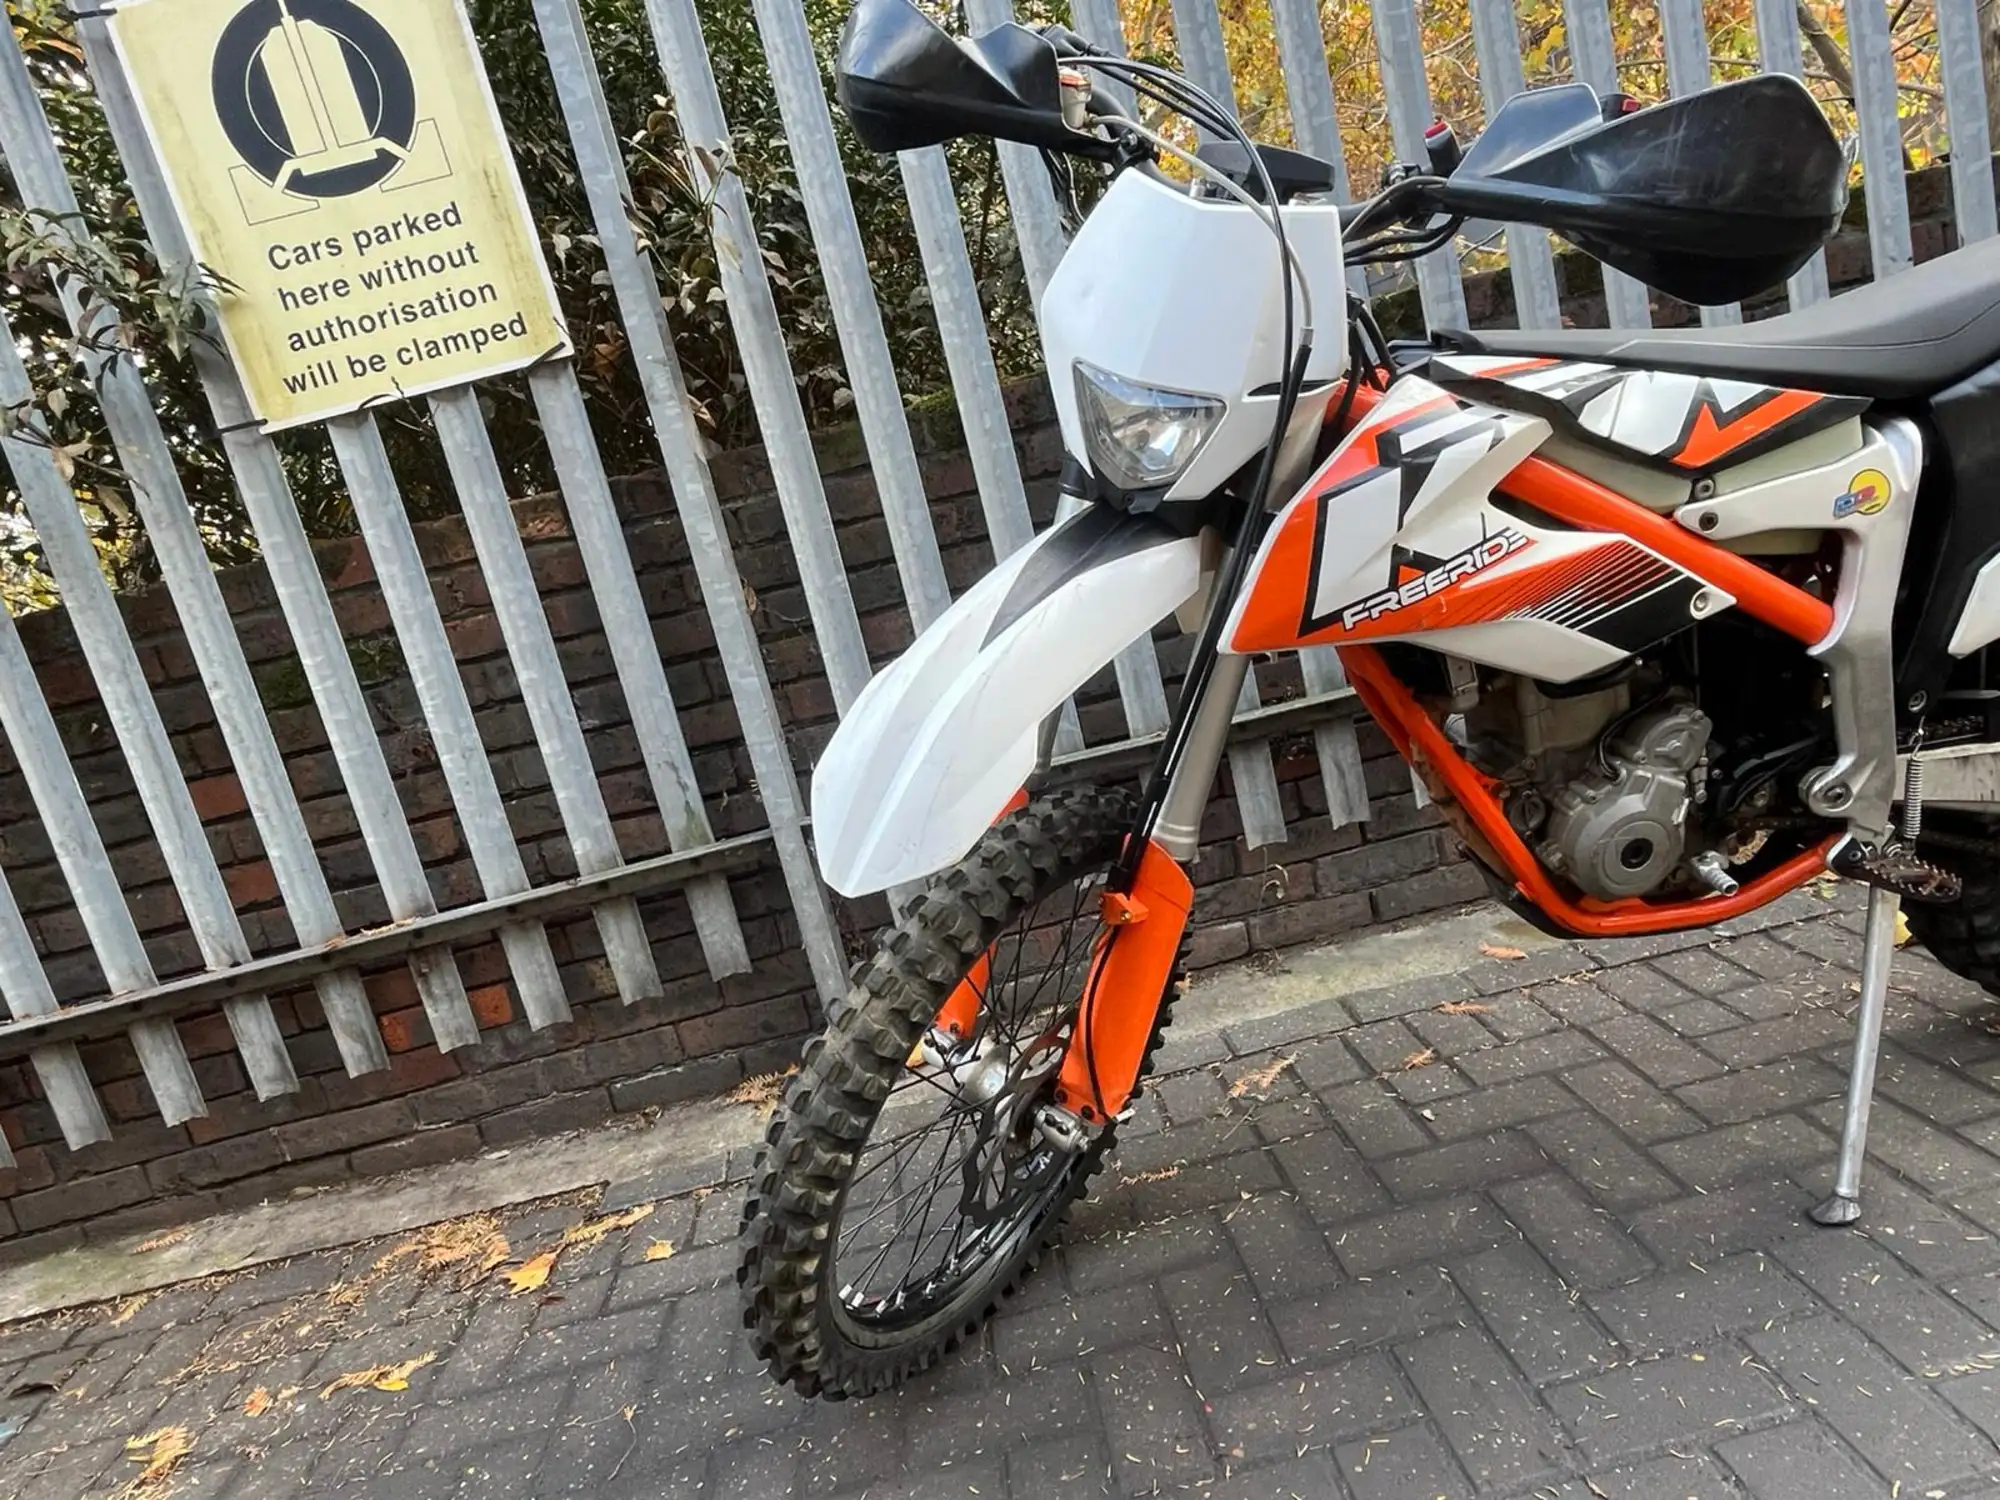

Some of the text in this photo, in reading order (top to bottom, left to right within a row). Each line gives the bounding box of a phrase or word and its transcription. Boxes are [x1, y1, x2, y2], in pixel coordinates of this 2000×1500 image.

[268, 201, 462, 270] Cars parked
[277, 241, 479, 311] here without
[282, 311, 528, 394] will be clamped
[288, 284, 497, 352] authorisation
[1341, 529, 1529, 630] FREERIDE
